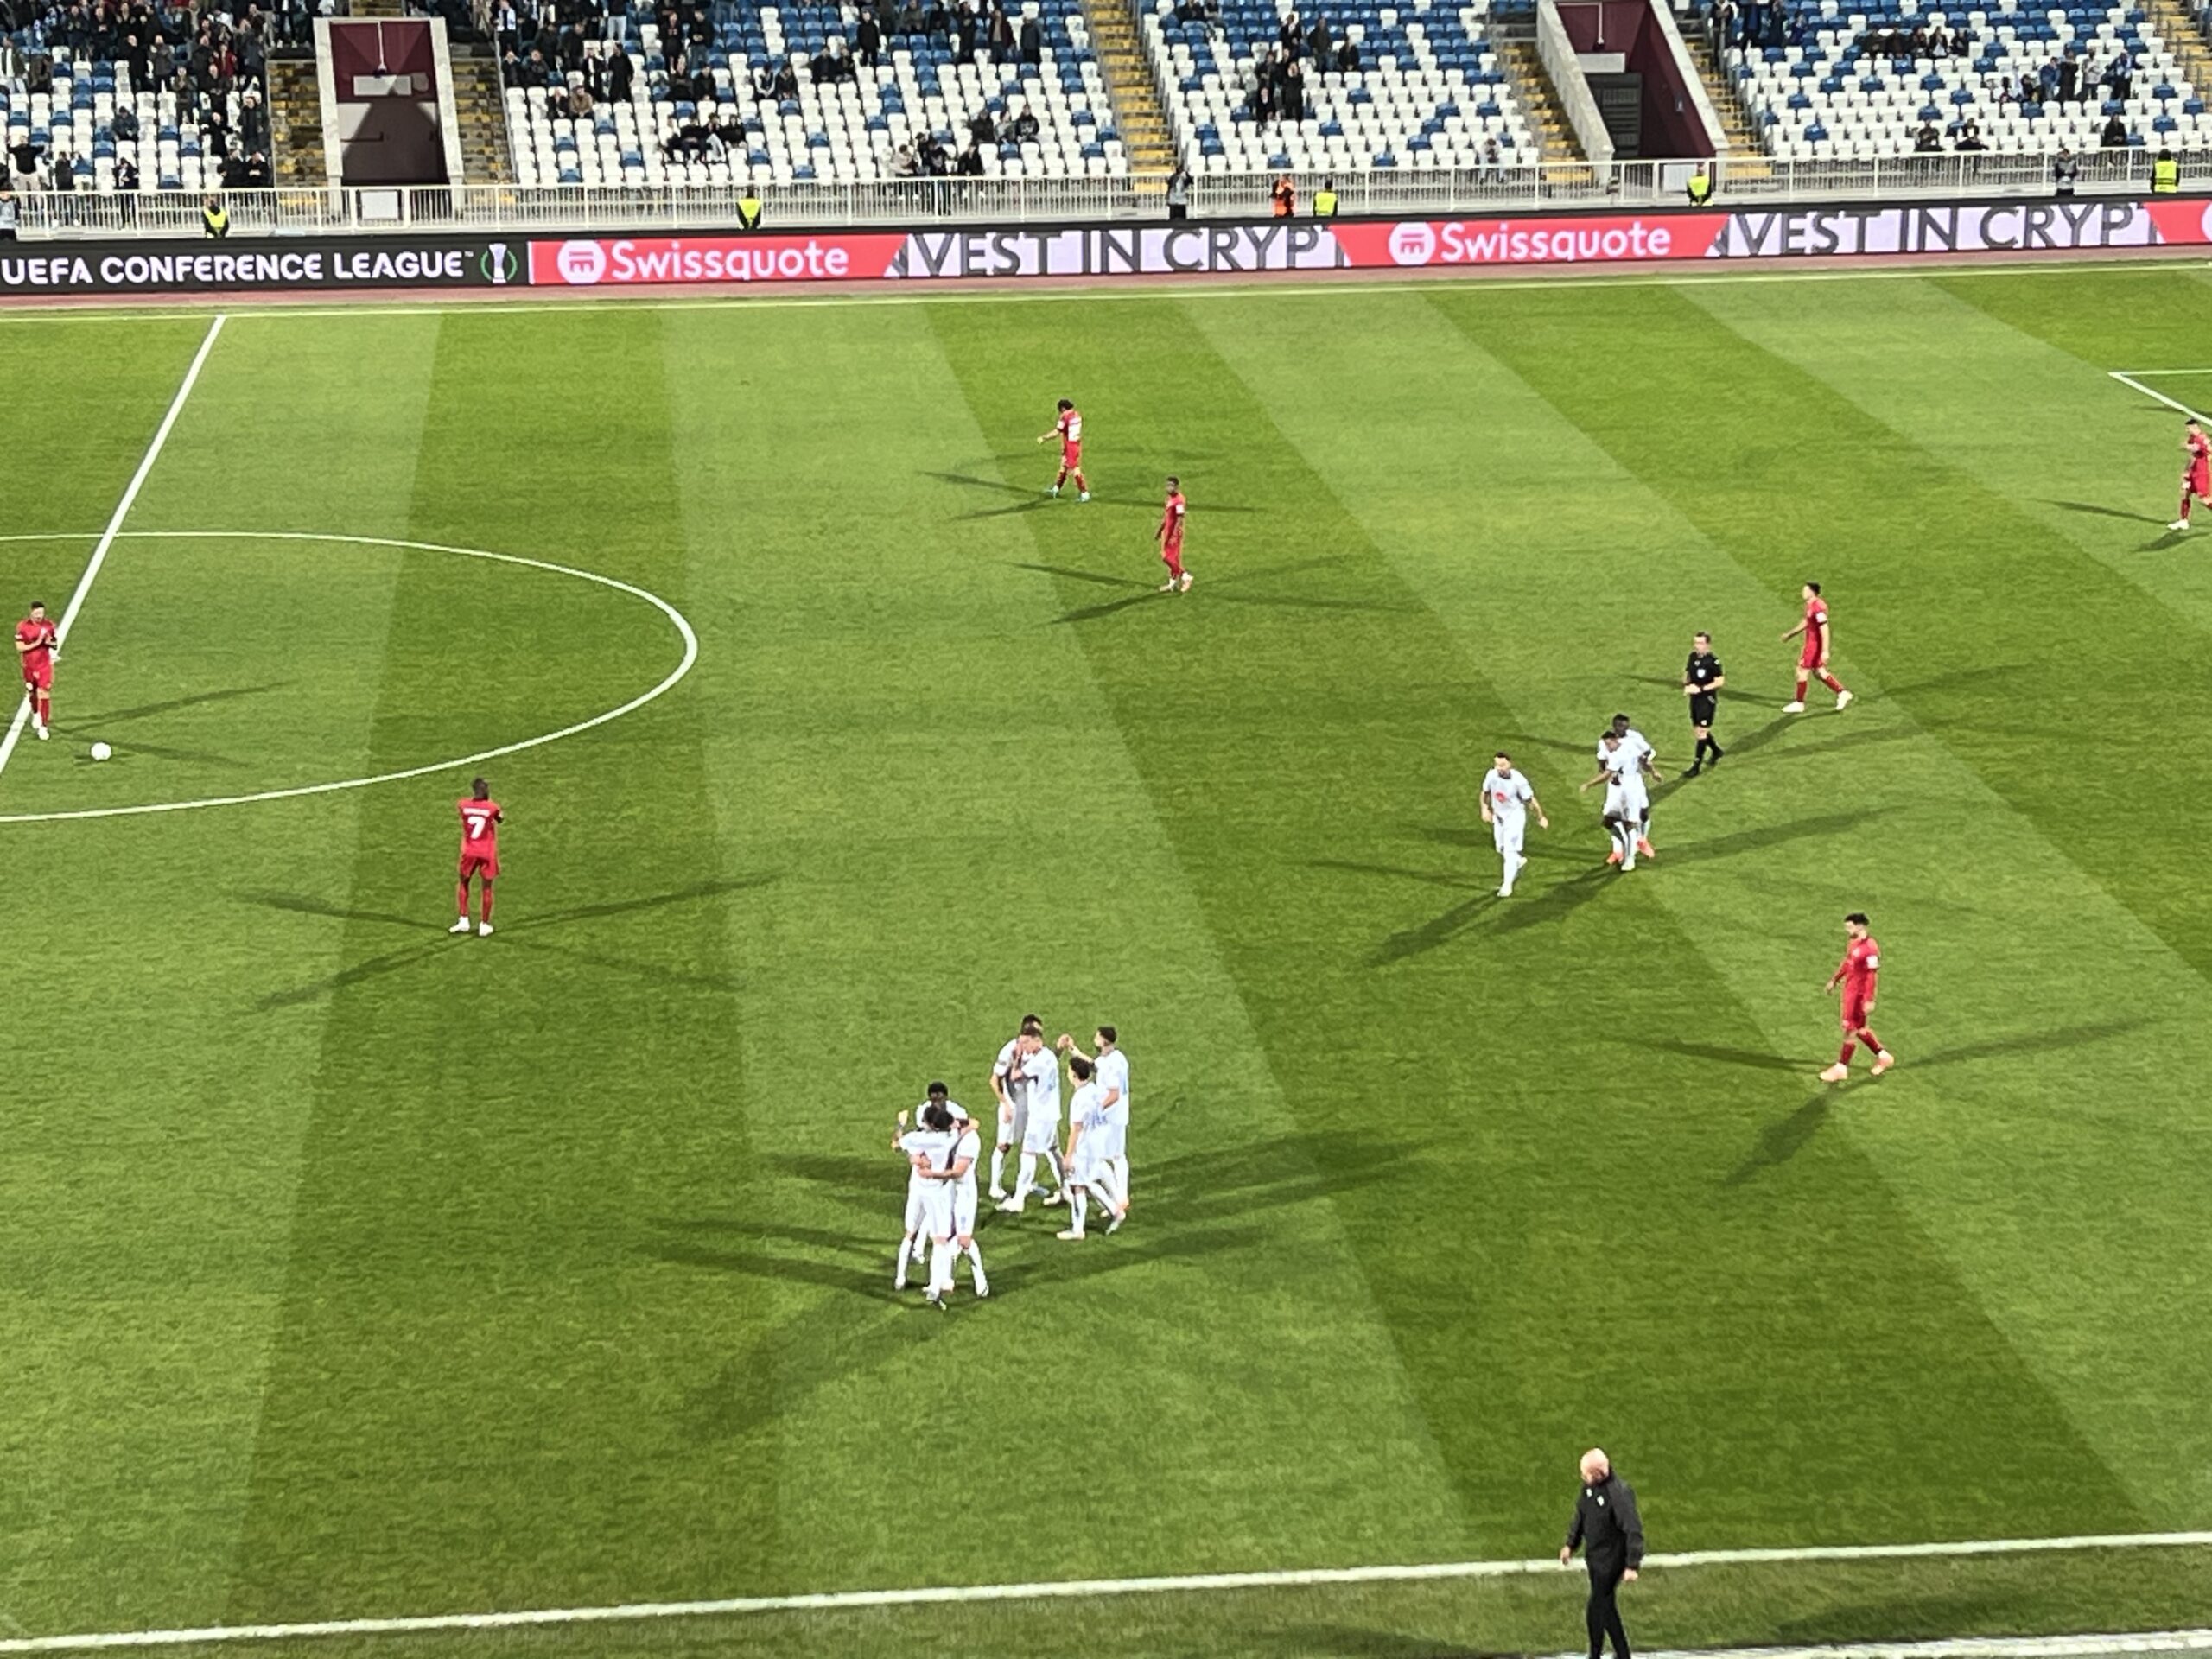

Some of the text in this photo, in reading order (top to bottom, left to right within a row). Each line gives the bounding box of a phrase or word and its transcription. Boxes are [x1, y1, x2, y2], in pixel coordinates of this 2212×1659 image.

[1440, 220, 1672, 262] Swissquote
[1900, 205, 1959, 252] IN
[2, 257, 93, 284] UEFA
[100, 253, 322, 283] CONFERENCE
[611, 240, 849, 281] Swissquote
[1082, 228, 1141, 272] IN
[467, 816, 486, 839] 7
